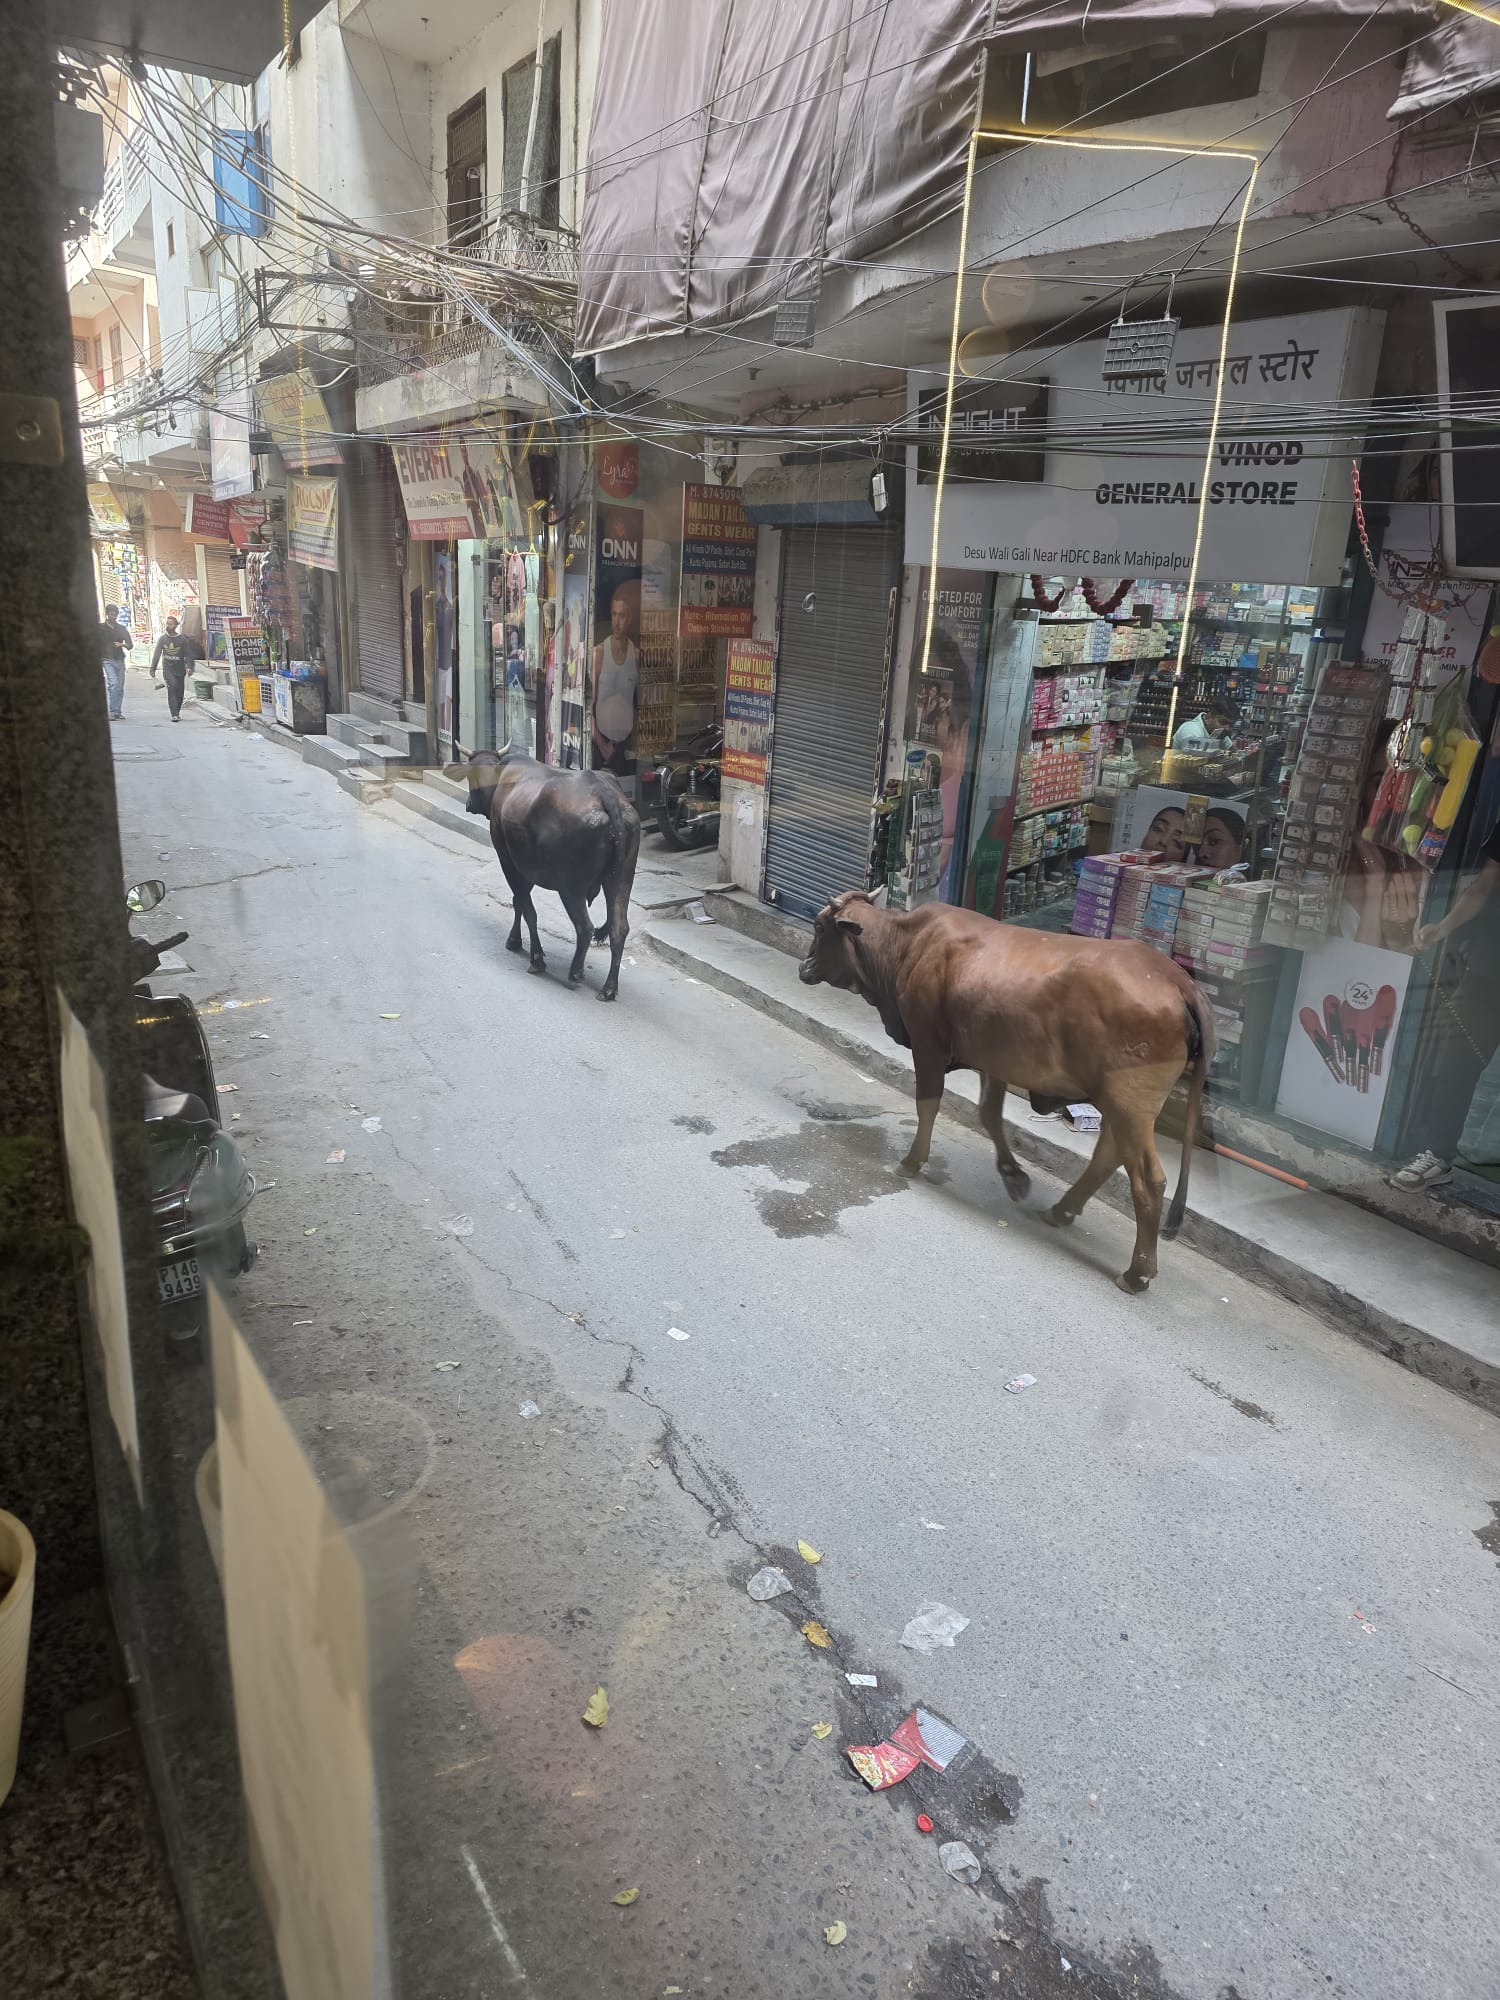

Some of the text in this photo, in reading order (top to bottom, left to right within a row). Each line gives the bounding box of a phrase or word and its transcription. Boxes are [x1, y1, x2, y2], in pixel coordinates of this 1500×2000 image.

[1258, 340, 1319, 383] स्टोर
[1218, 441, 1304, 466] VINOD
[1096, 481, 1298, 505] GENERAL STORE
[689, 501, 747, 523] MADAN TAILO
[688, 523, 755, 539] GENTS WEAR
[602, 538, 637, 560] ONN
[964, 546, 986, 559] Desu
[988, 547, 1010, 561] Wali
[1012, 547, 1031, 561] Gali
[1033, 548, 1058, 562] Near
[1060, 548, 1090, 564] HDFC
[1093, 549, 1121, 565] Bank
[922, 590, 983, 604] CAFTED FOR
[939, 605, 981, 619] COMFORT
[235, 648, 262, 656] CREDI
[1352, 988, 1368, 1001] 24
